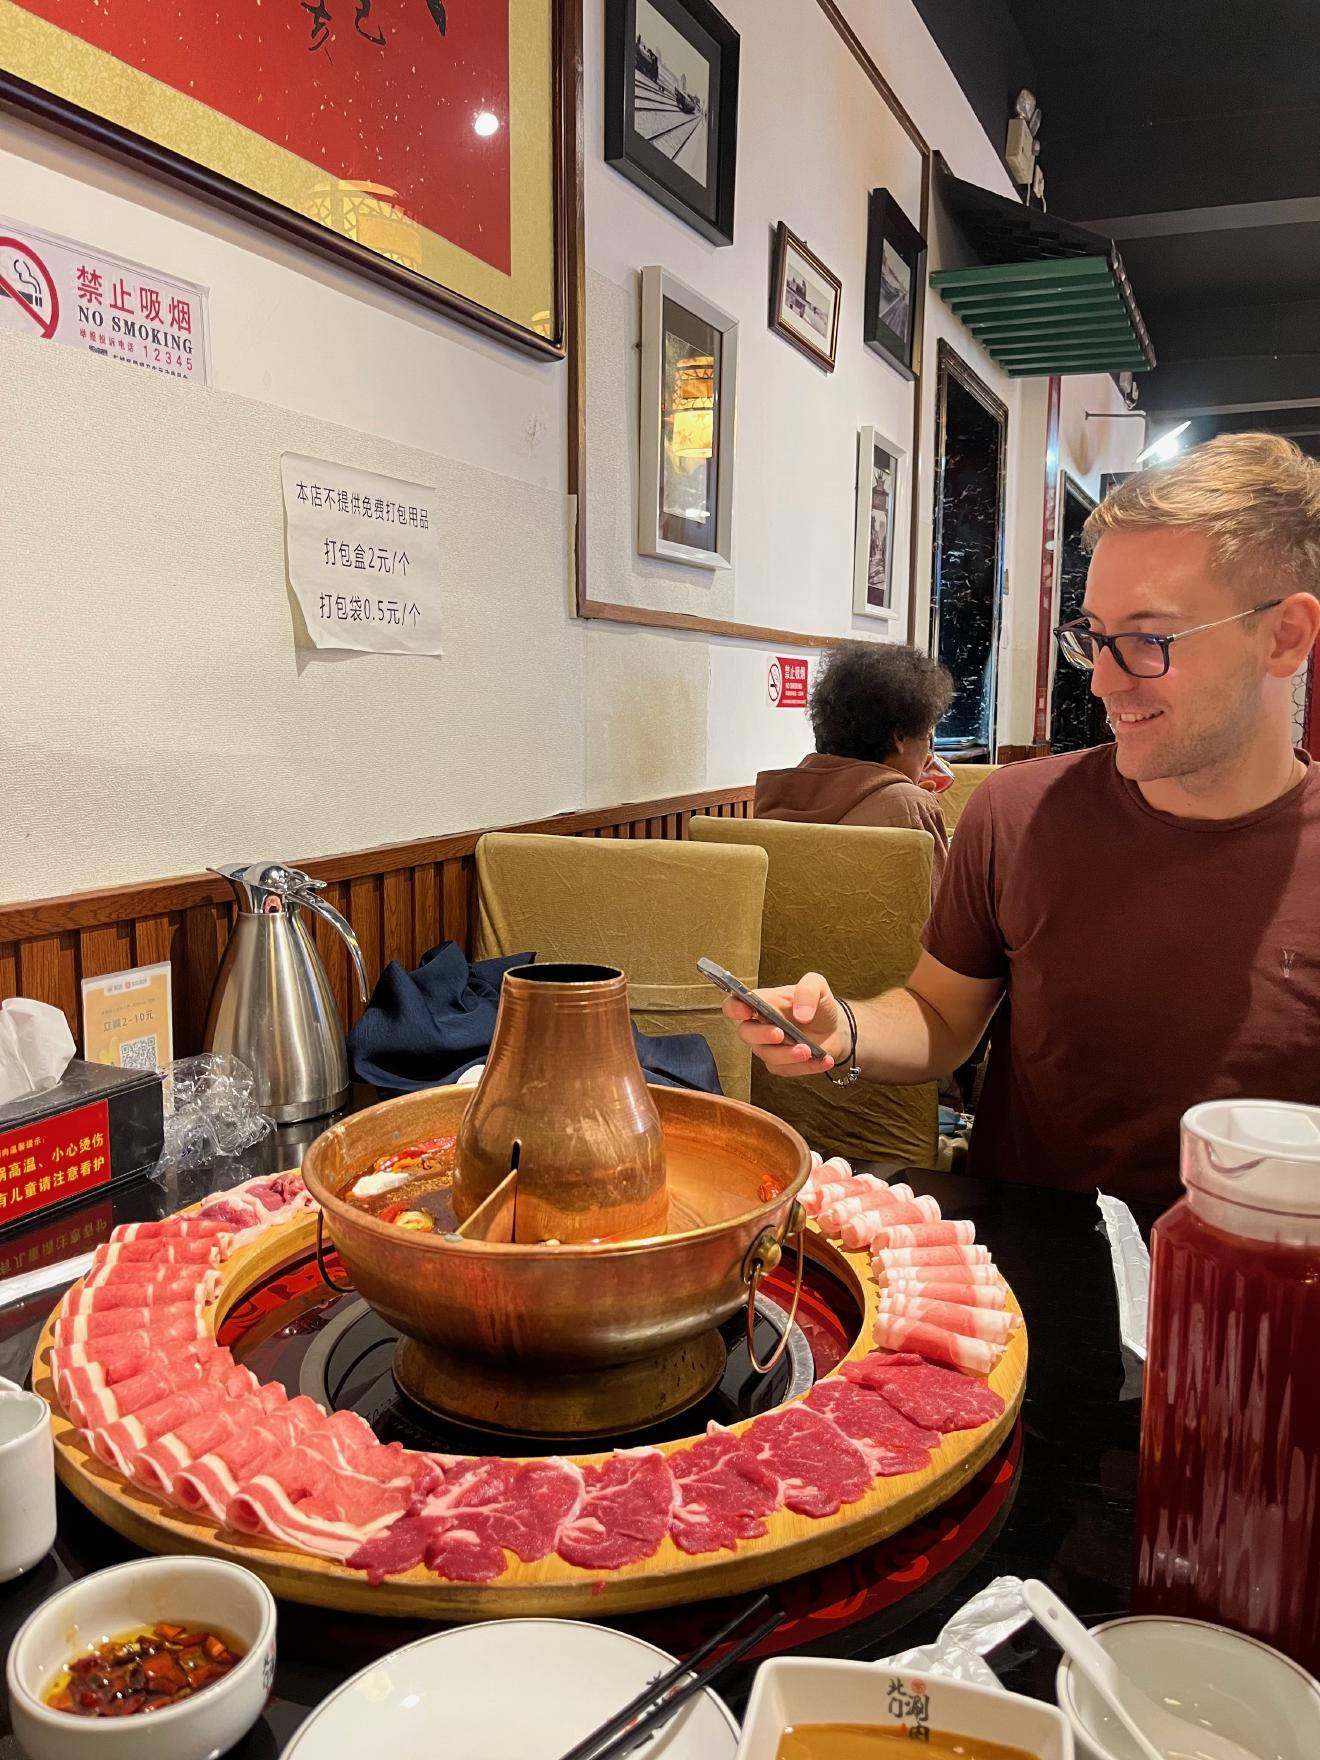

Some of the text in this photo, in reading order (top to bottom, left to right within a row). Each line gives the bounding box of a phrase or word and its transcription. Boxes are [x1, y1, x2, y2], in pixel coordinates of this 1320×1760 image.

[76, 265, 192, 335] 禁止吸烟
[78, 305, 193, 355] NO SMOKING
[79, 328, 135, 353] 举报投诉电话
[143, 345, 193, 371] 12345
[296, 481, 429, 529] 本店不提供免费打包用品
[324, 538, 410, 576] 打包盒2元/个
[320, 592, 421, 627] 打包袋0.5元/个
